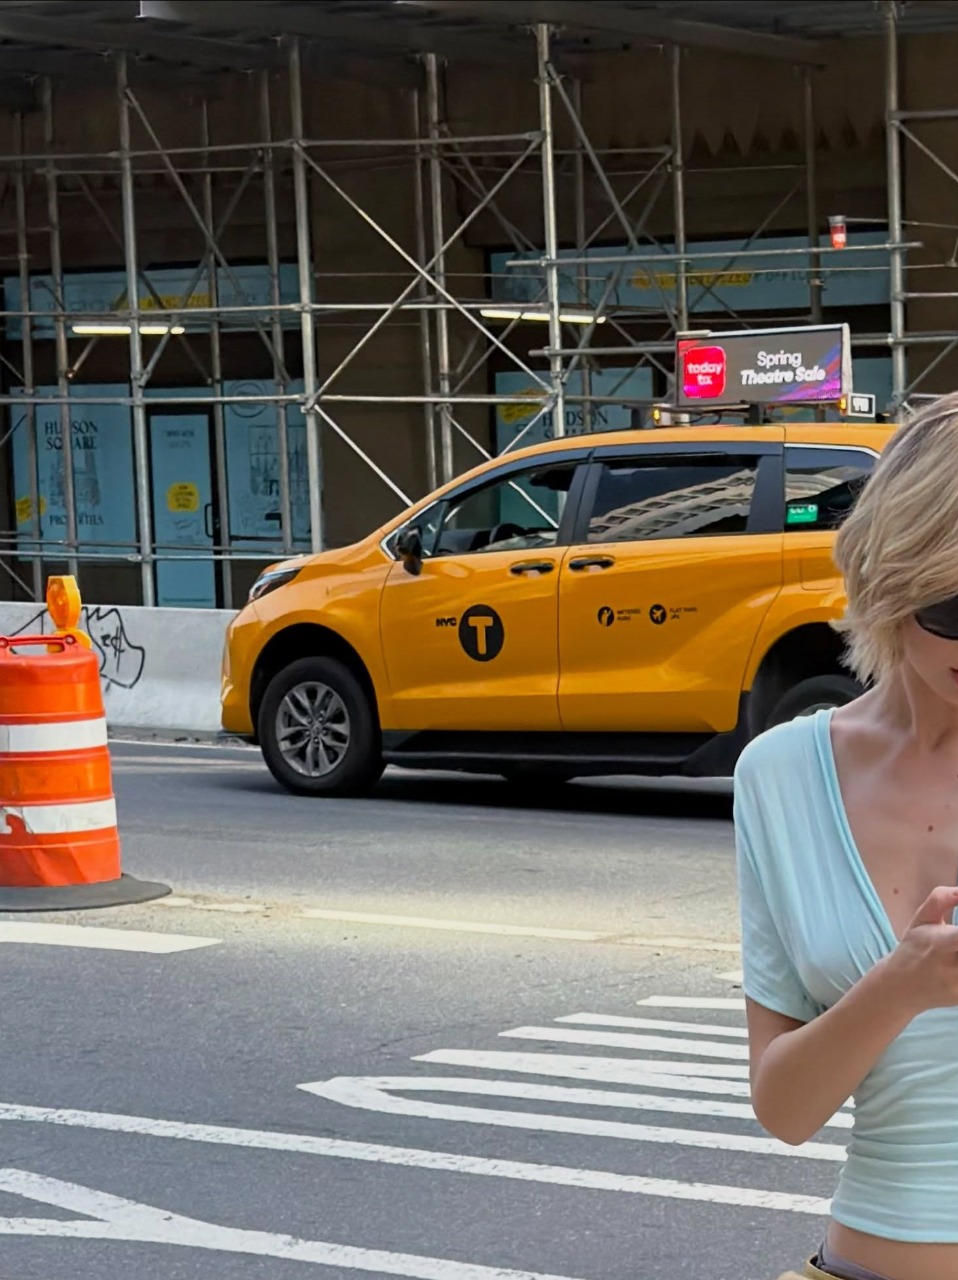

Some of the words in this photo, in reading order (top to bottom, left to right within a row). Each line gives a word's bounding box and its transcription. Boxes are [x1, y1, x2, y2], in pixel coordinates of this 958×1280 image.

[757, 350, 802, 368] Spring
[687, 361, 723, 374] today
[740, 368, 793, 385] Theatre
[795, 366, 826, 382] Sale
[45, 420, 98, 435] HUSON
[46, 436, 98, 450] SQARE
[436, 617, 458, 627] NYC
[467, 615, 494, 656] T
